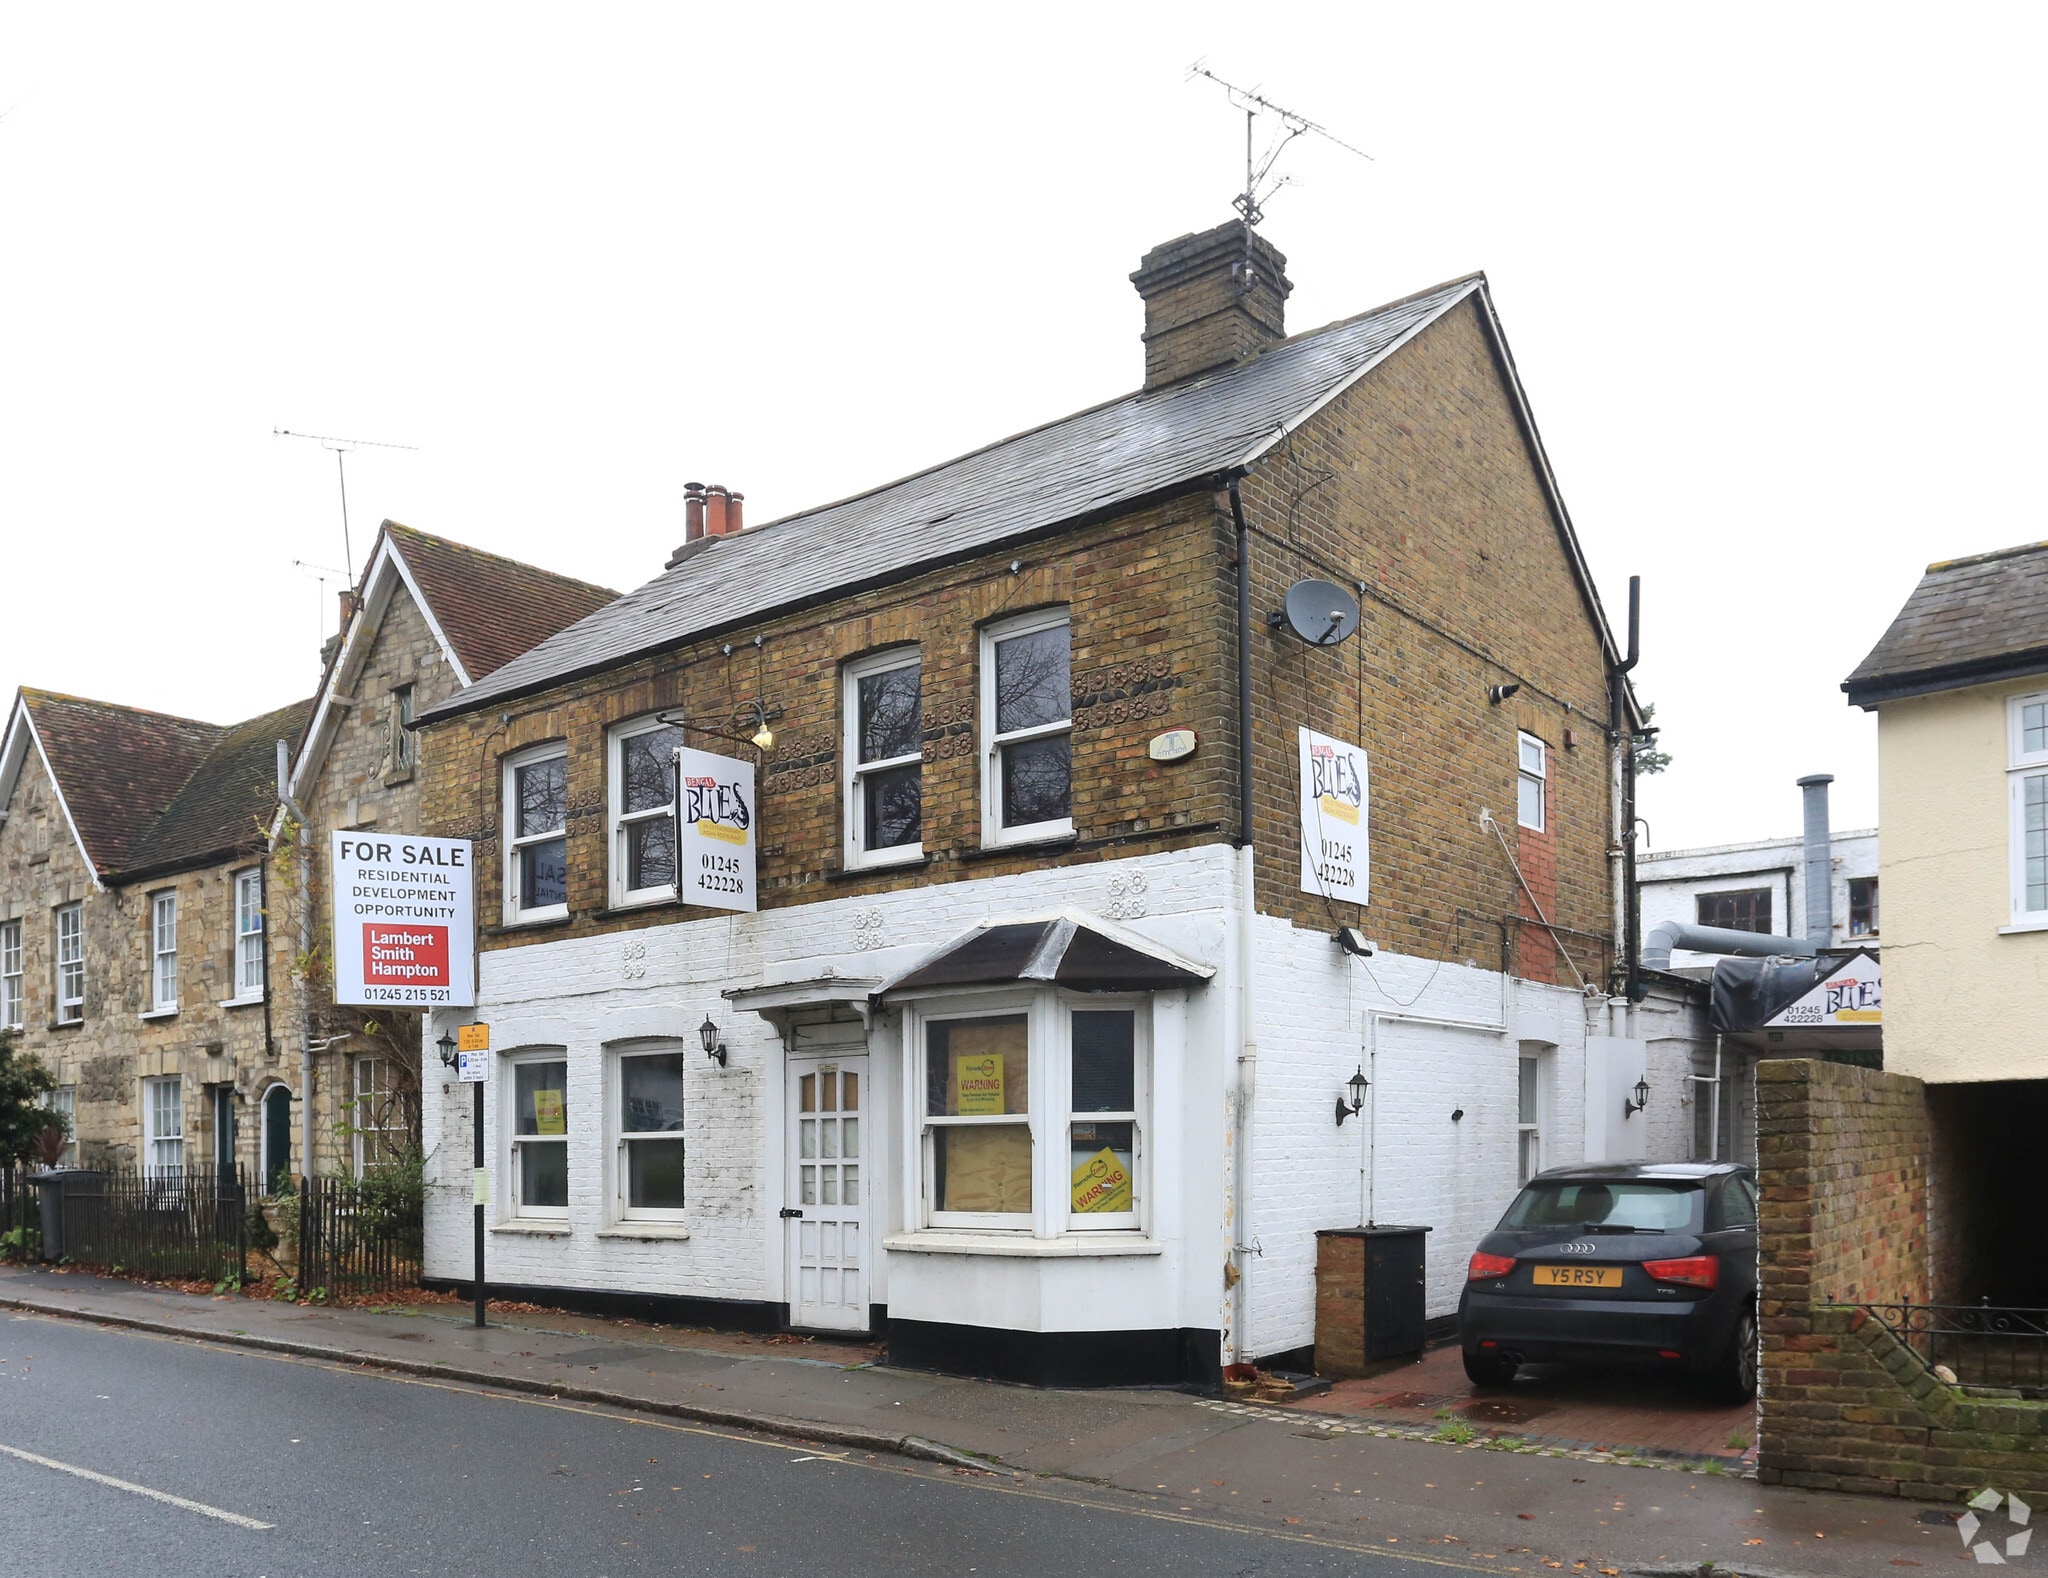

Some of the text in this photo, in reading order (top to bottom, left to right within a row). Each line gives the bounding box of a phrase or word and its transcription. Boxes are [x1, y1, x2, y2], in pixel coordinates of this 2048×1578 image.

[687, 778, 714, 787] BENGAL
[1312, 753, 1361, 808] BLUES
[686, 783, 749, 830] BLUES
[341, 841, 464, 867] FOR SALE
[1322, 839, 1352, 863] 01245
[702, 854, 739, 874] 01245
[358, 869, 450, 884] RESIDENTIAL
[1318, 863, 1354, 887] 422228
[698, 874, 743, 894] 422228
[353, 886, 456, 901] DEVELOPMENT
[354, 904, 455, 918] OPPORTUNITY
[371, 930, 434, 946] Lambert
[371, 946, 414, 960] Smith
[372, 961, 438, 979] Hampton
[364, 988, 450, 1001] 01245 215 521
[1788, 1006, 1820, 1014] 01245
[1784, 1015, 1823, 1023] 422228
[961, 1079, 1000, 1090] WARNING
[1093, 1164, 1105, 1174] Zone
[1076, 1170, 1123, 1208] WARNING
[1552, 1269, 1605, 1284] Y5 RSY
